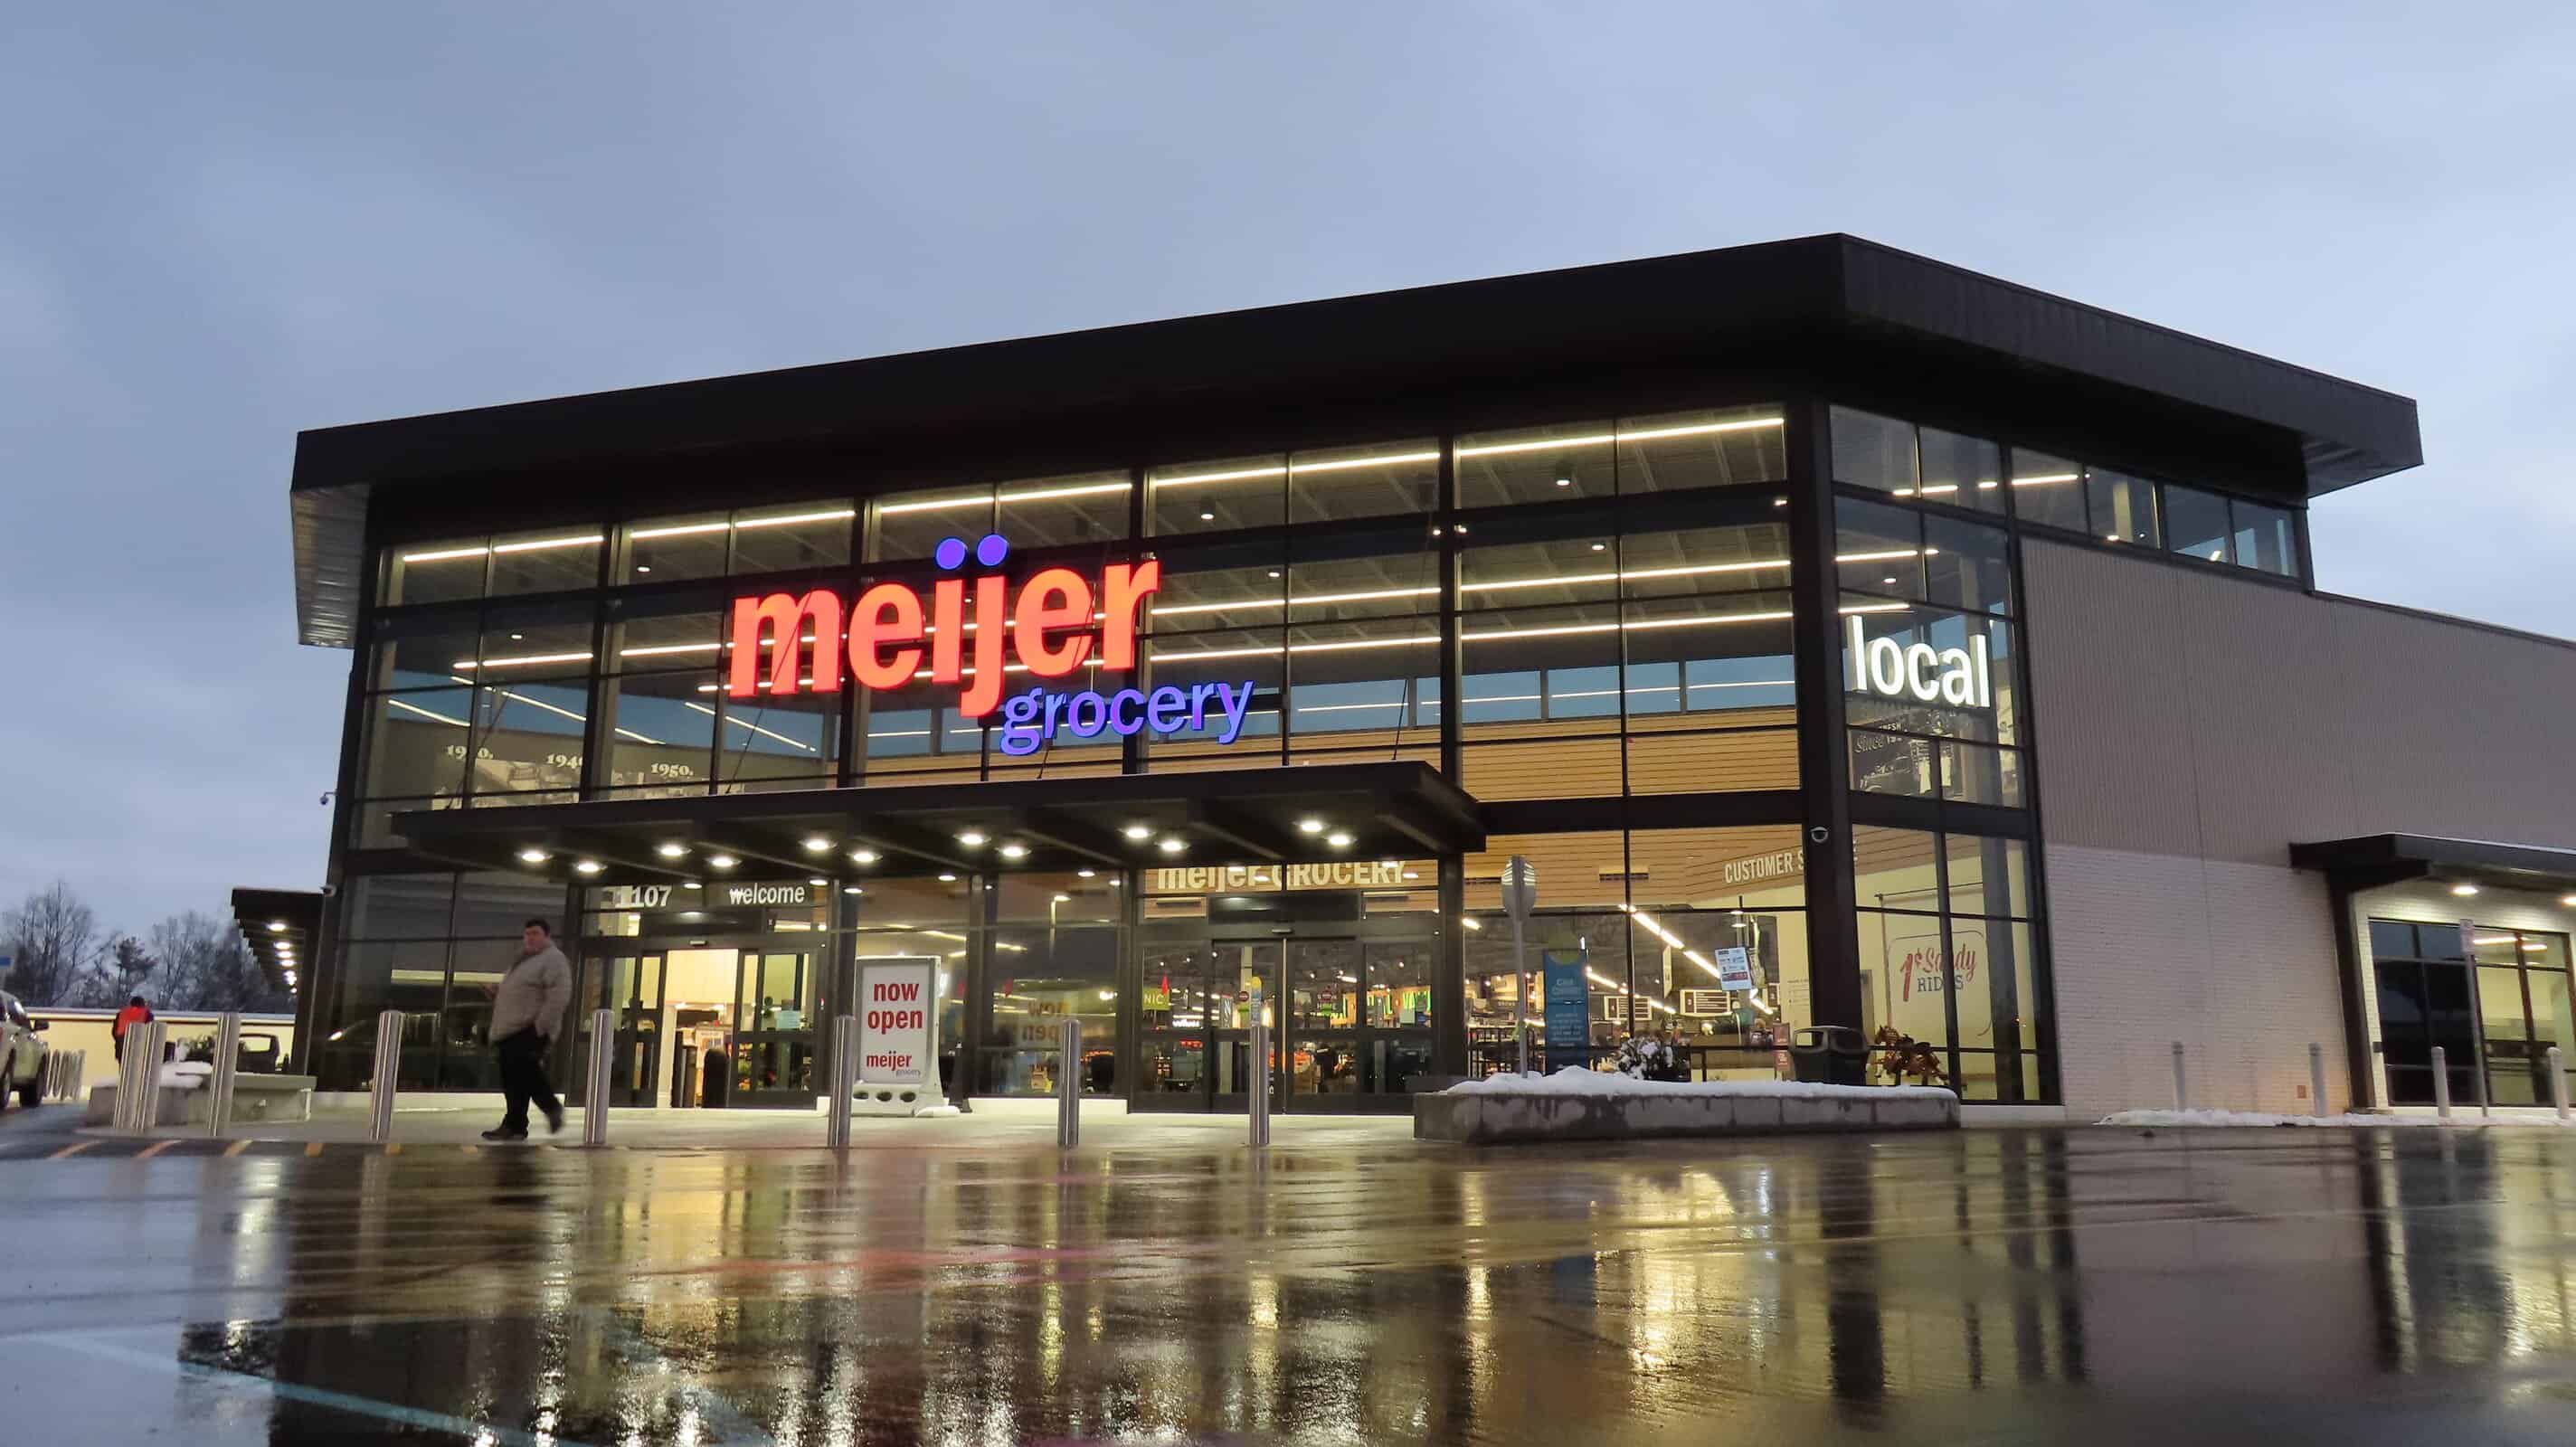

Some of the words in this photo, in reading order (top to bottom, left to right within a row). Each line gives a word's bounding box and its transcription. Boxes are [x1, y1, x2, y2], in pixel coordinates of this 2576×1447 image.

[729, 534, 1159, 717] meijer
[1845, 614, 1991, 708] local
[999, 681, 1254, 755] grocery
[447, 744, 494, 760] 190.
[650, 762, 695, 777] 1950.
[1724, 852, 1794, 884] CUSTOMER
[729, 883, 805, 904] welcome
[1923, 943, 1976, 983] Sady
[874, 983, 919, 1002] now
[1918, 975, 1964, 992] RIDS
[867, 1009, 923, 1035] open
[867, 1051, 913, 1071] meijer
